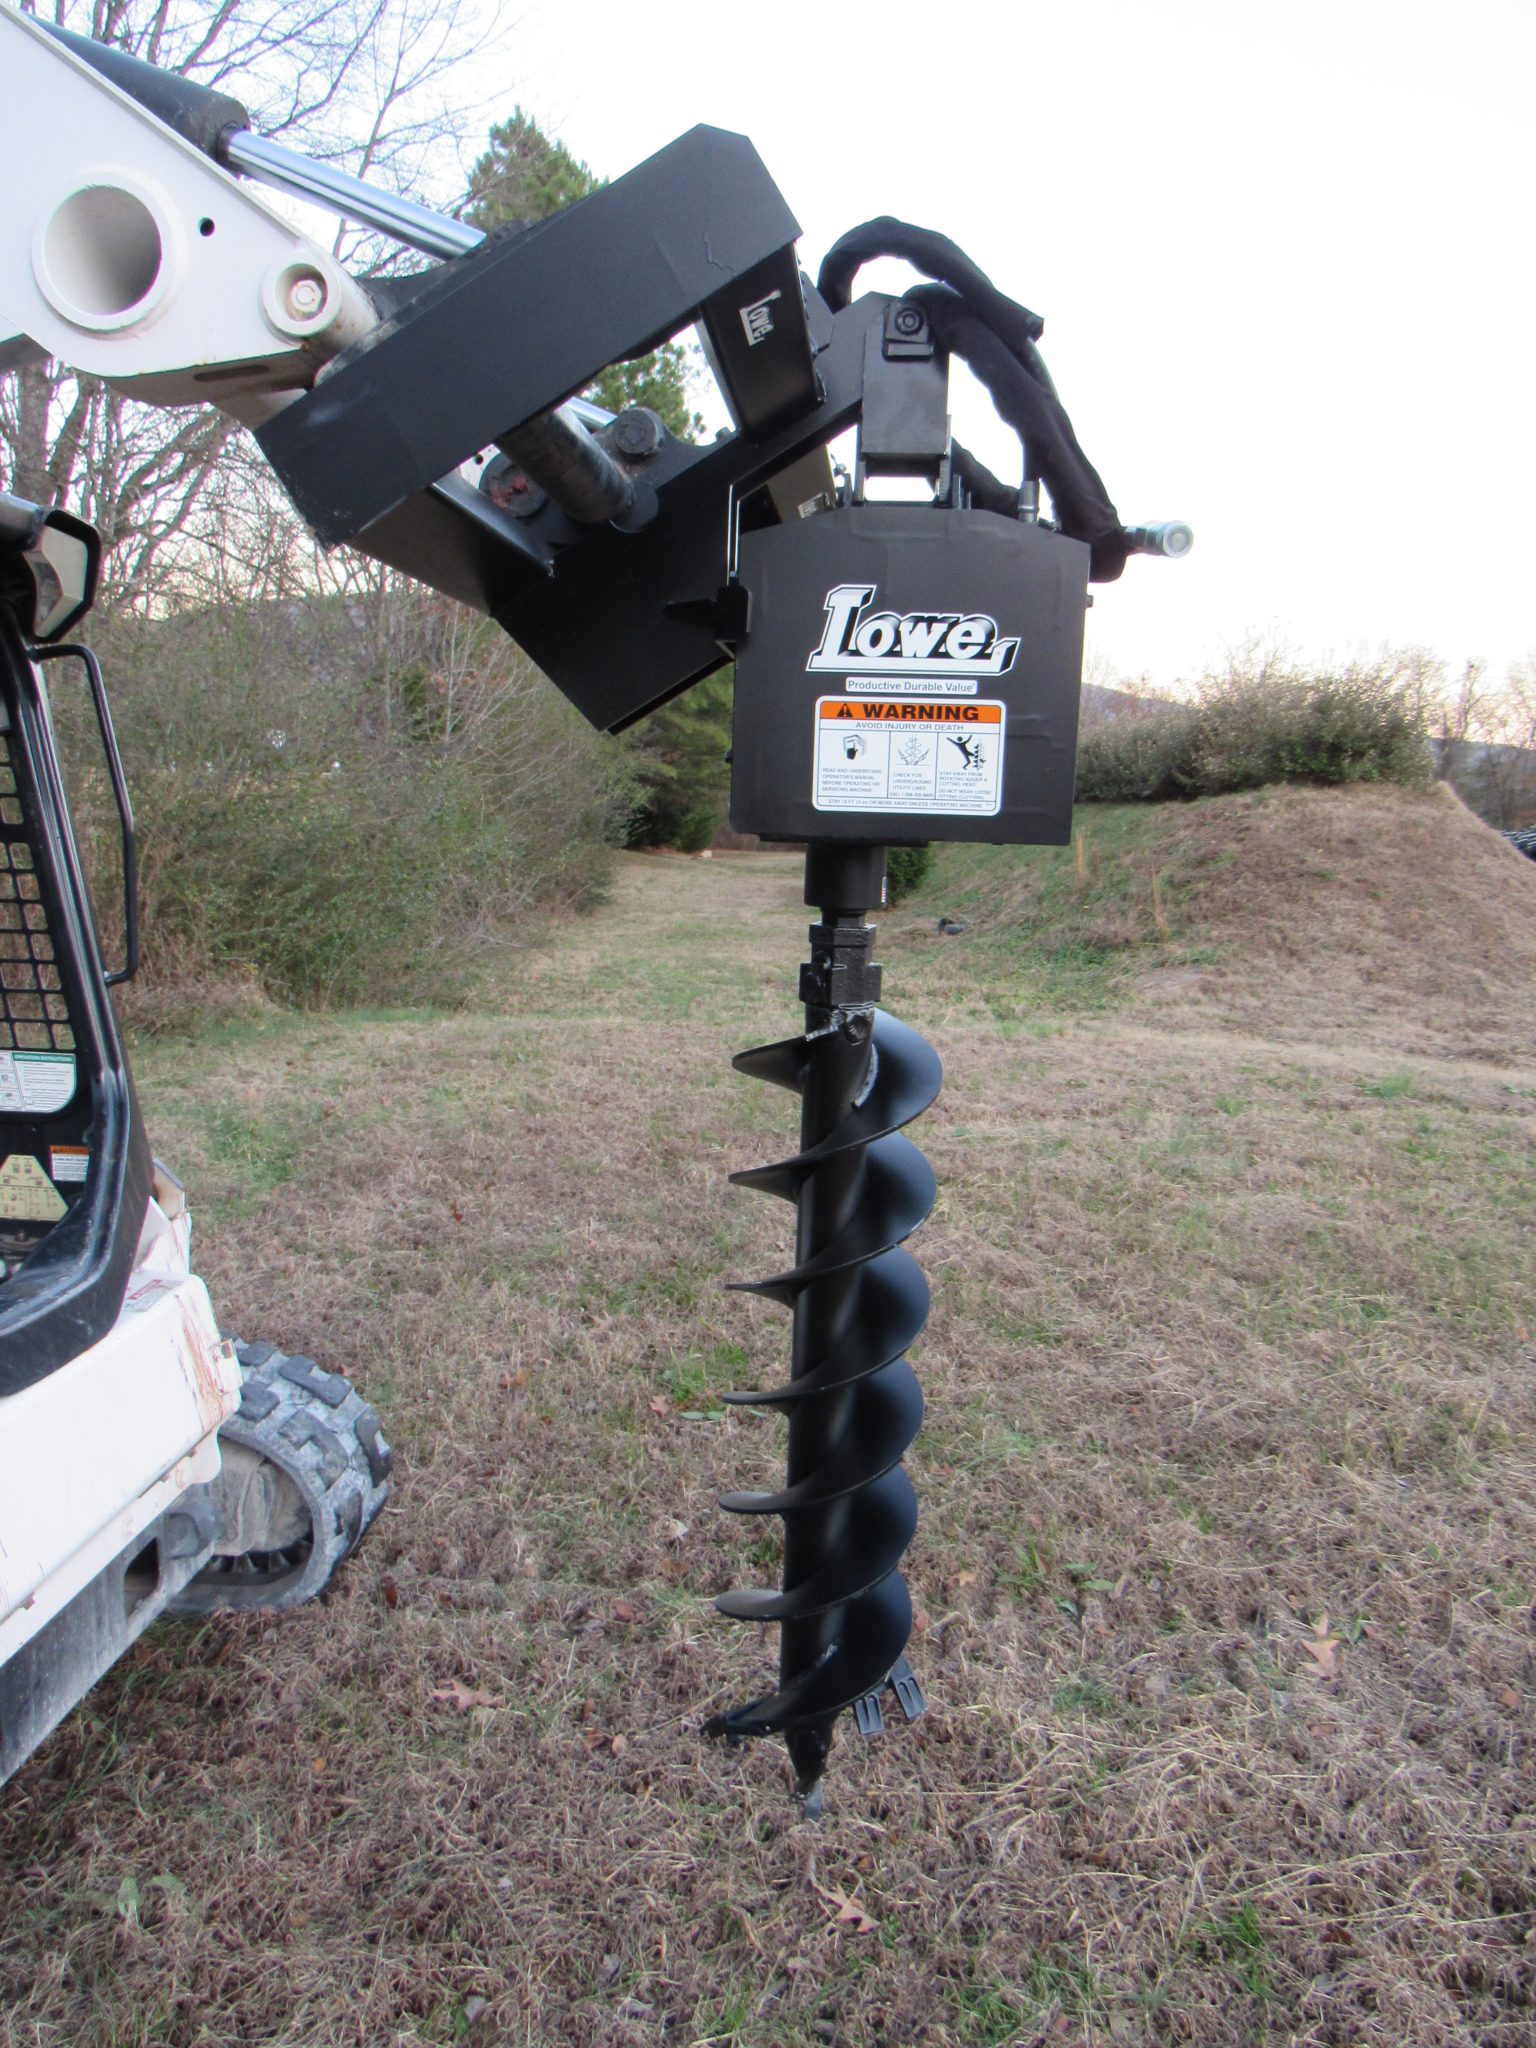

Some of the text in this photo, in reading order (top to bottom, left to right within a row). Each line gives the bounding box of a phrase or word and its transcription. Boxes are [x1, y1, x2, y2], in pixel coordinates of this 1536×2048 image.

[739, 289, 782, 346] Lowe
[805, 584, 1022, 676] Lowe
[848, 680, 901, 691] Productive
[904, 681, 943, 692] Durable
[863, 703, 979, 720] WARNING
[885, 722, 917, 730] INJURY
[934, 723, 964, 731] DEATH
